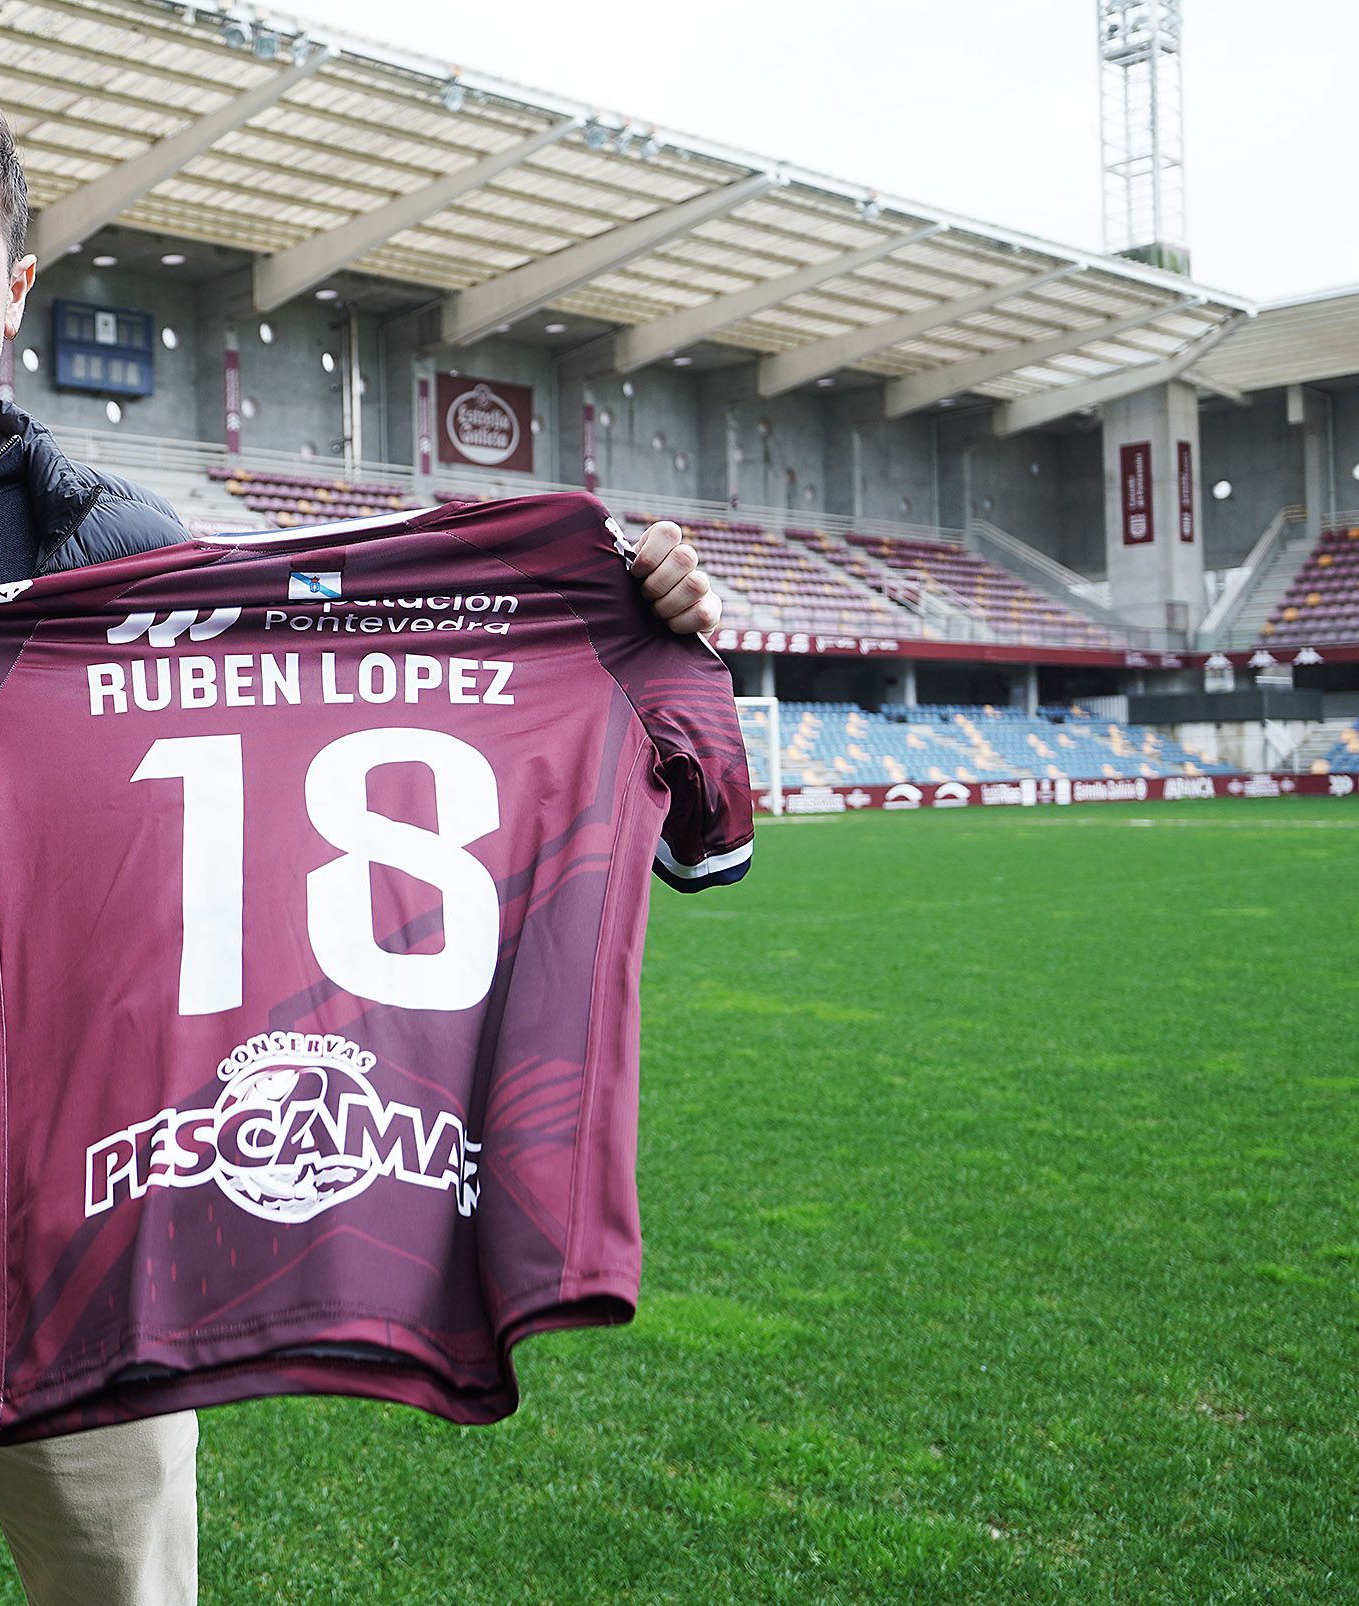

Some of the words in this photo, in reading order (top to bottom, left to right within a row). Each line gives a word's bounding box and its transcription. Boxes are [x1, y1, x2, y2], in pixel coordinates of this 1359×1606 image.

[264, 610, 511, 635] Pontevedra
[86, 653, 303, 717] RUBEN
[321, 652, 516, 706] LOPEZ
[129, 727, 501, 1016] 18
[216, 1030, 378, 1083] CONSERVAS
